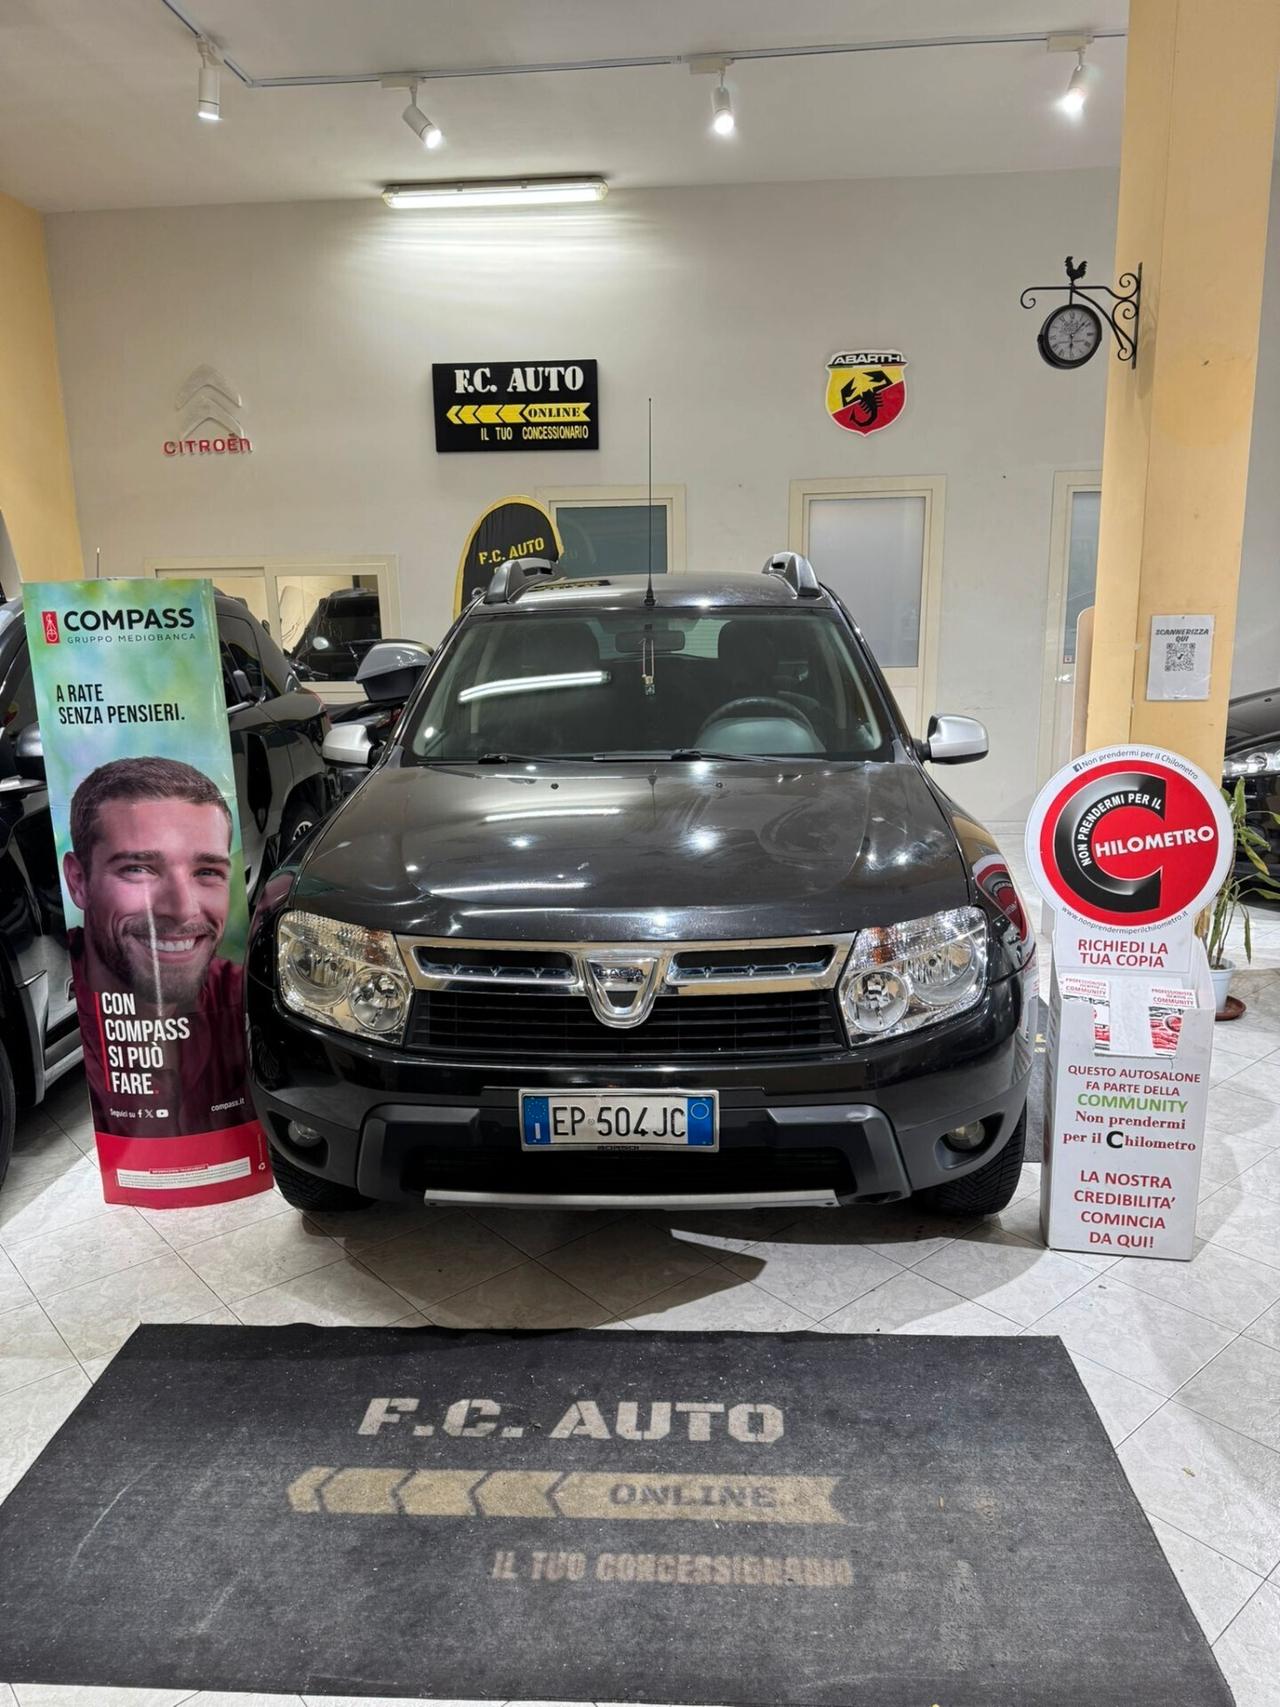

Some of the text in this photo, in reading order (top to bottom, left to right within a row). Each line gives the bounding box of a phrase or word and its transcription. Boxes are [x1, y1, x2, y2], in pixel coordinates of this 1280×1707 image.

[834, 354, 900, 364] ABARTH
[454, 365, 585, 394] F.C. AUTO
[527, 406, 581, 418] ONLINE
[480, 425, 589, 441] IL TUO CONCESSIONARIO
[478, 536, 546, 566] F.C. AUTO
[63, 608, 195, 631] COMPASS
[66, 632, 196, 644] GRUPPO MEDIOBANCA
[56, 683, 105, 702] A RATE
[58, 702, 186, 725] SENZA PENSIERI.
[1081, 748, 1199, 781] Non prendermi per il Chilometro
[1077, 793, 1163, 867] NON PRENDERMI PER IL
[1094, 825, 1215, 858] HILOMETRO
[1061, 906, 1189, 935] www.nonprendermiperilchilometro.it
[1077, 938, 1169, 955] RICHIEDI LA
[1080, 952, 1165, 968] TUA COPIA
[101, 991, 136, 1015] CON
[1152, 996, 1194, 1006] COMMUNITY
[105, 1016, 191, 1042] COMPASS
[109, 1041, 164, 1068] SI PUÒ
[1068, 1064, 1201, 1083] QUESTO AUTOSALONE
[1086, 1081, 1180, 1096] FA PARTE DELLA
[109, 1108, 136, 1118] Seguici su
[210, 1097, 246, 1112] compass.it
[1077, 1093, 1188, 1114] COMMUNITY
[552, 1106, 586, 1136] EP
[1075, 1110, 1186, 1130] Non prendermi
[1063, 1130, 1196, 1151] per il Chilometro
[1080, 1169, 1172, 1189] LA NOSTRA
[1080, 1210, 1166, 1229] COMINCIA
[1089, 1231, 1154, 1249] DA QUI!
[357, 1397, 786, 1444] F.C. AUTO
[609, 1483, 778, 1509] ONLINE
[491, 1551, 518, 1580] IL
[530, 1550, 586, 1581] TUO
